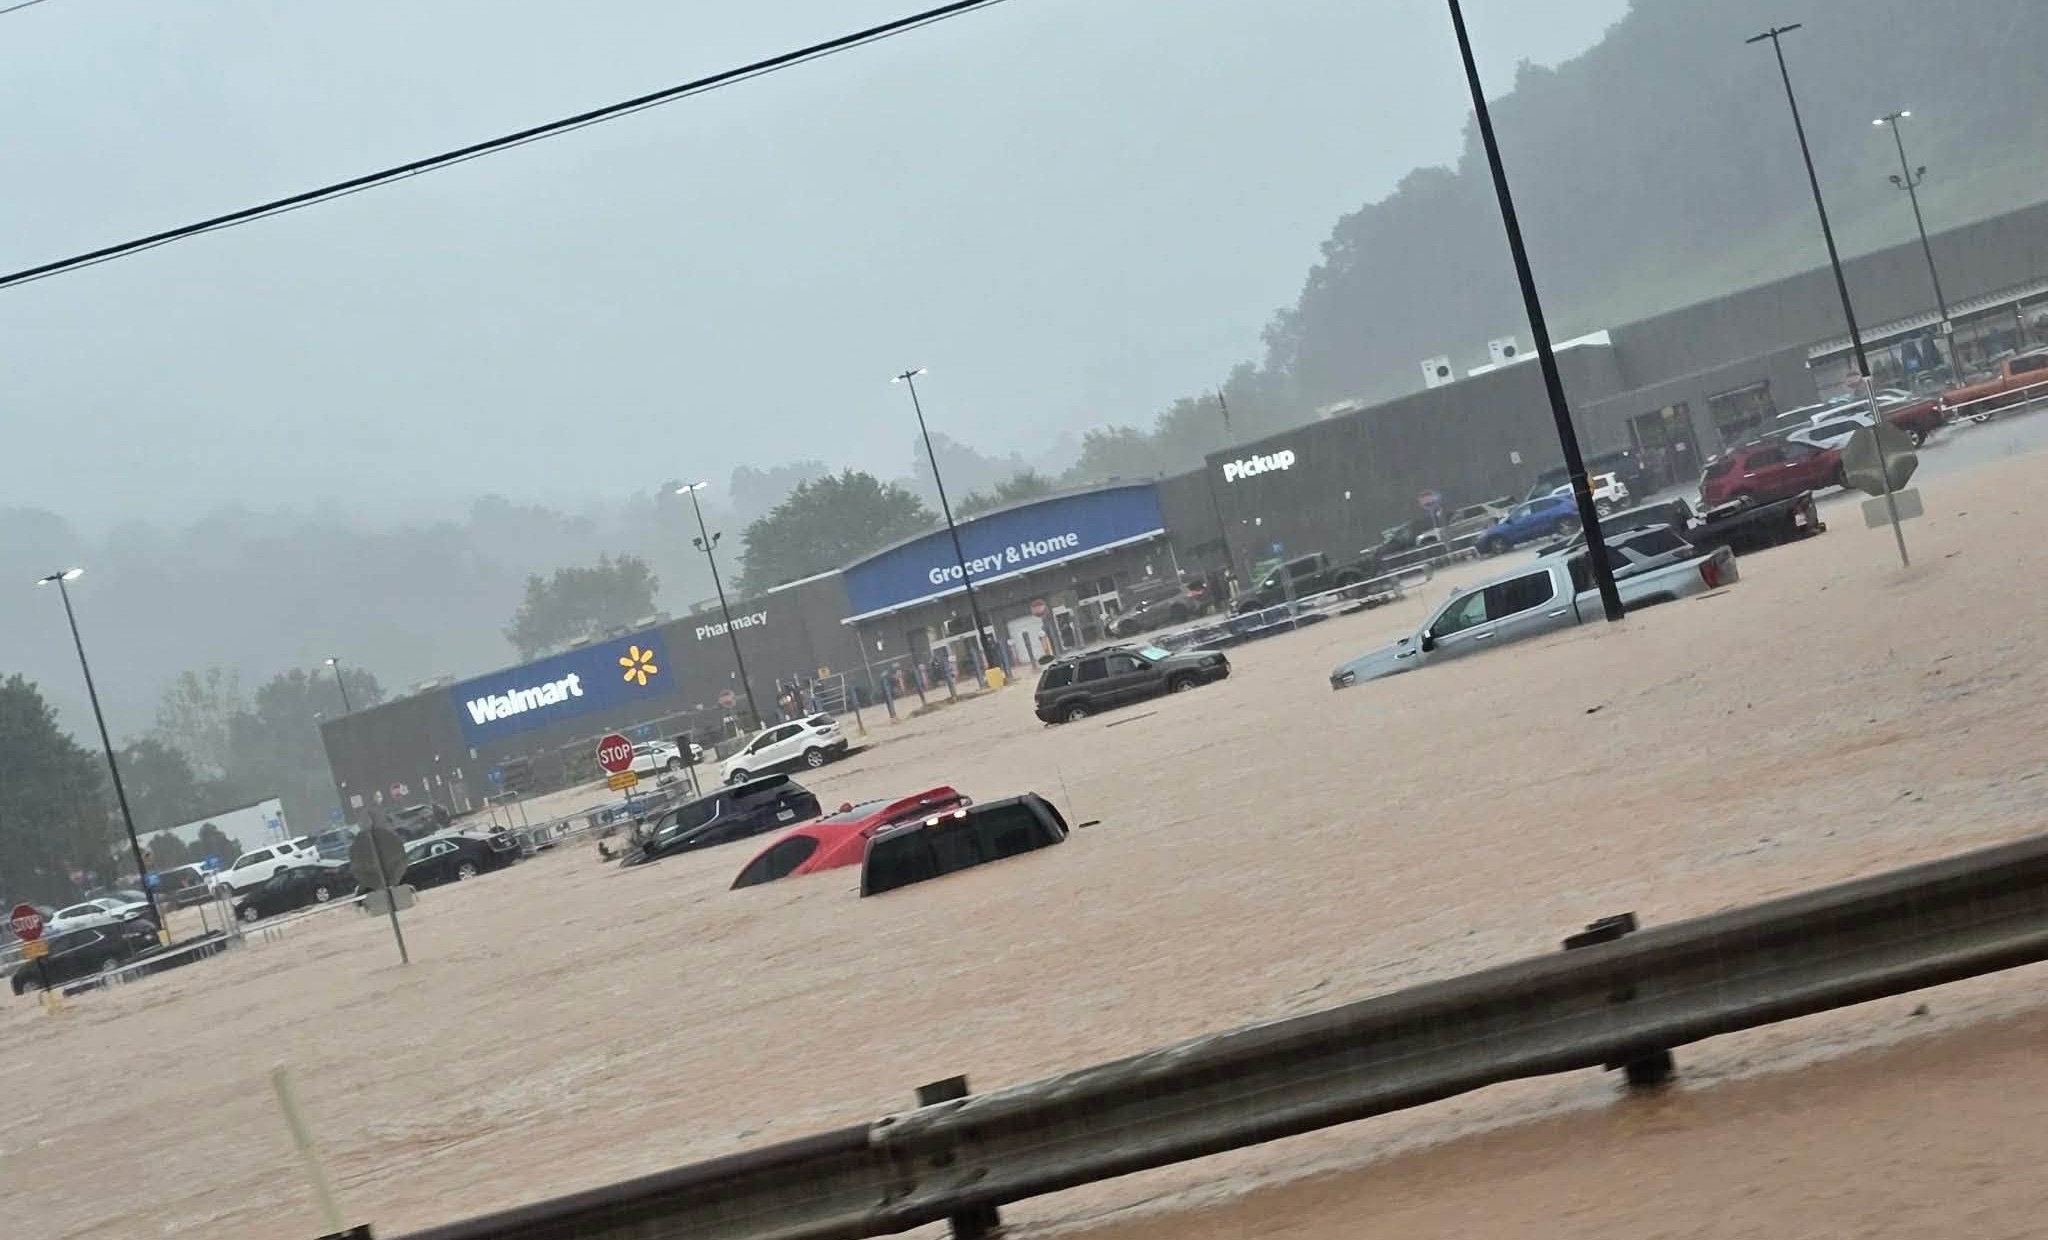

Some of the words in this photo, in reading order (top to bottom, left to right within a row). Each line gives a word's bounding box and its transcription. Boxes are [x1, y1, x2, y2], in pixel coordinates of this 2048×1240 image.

[1223, 450, 1295, 482] Pickup
[928, 552, 1003, 585] Grocery
[1005, 546, 1021, 564] &
[1020, 532, 1079, 559] Home
[695, 611, 767, 640] Pharmacy
[466, 673, 584, 725] Walmart
[600, 743, 630, 764] STOP
[12, 914, 41, 933] STOP
